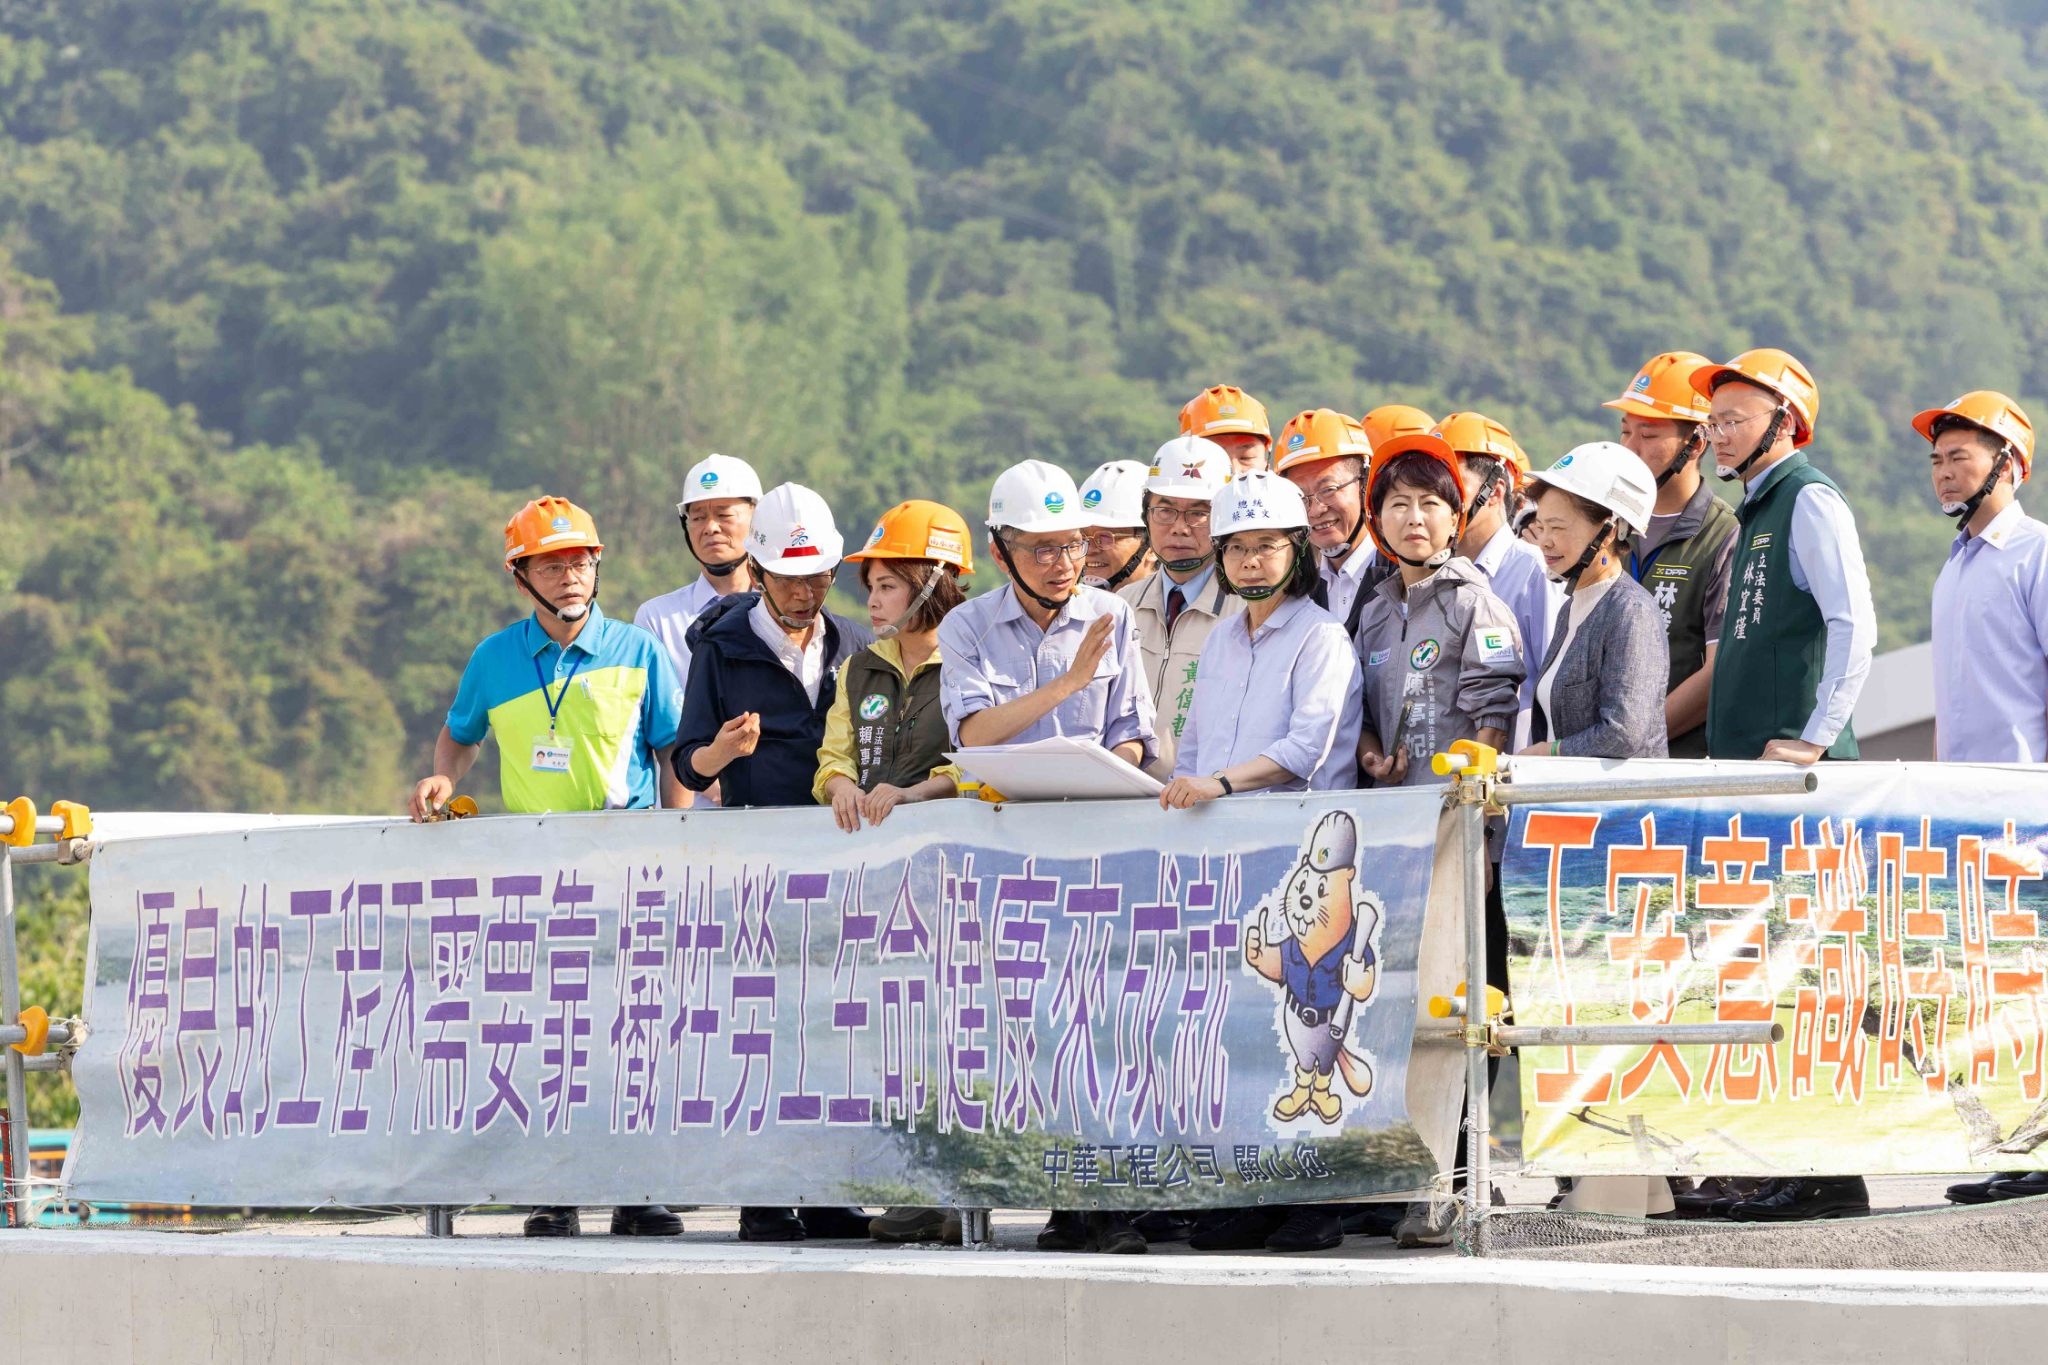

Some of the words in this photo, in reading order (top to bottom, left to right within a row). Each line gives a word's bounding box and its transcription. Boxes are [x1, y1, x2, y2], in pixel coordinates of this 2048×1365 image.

[1232, 509, 1270, 522] 蔡英文
[1237, 498, 1263, 509] 總統
[1664, 568, 1688, 576] DPP
[1751, 552, 1767, 625] 立法委員
[1733, 561, 1755, 640] 林宜瑾
[1402, 672, 1428, 760] 陳亭妃
[872, 725, 886, 766] 立法委員
[1522, 811, 2046, 1105] 工安意識時時
[1042, 1142, 1226, 1188] 中華工程公司
[1232, 1143, 1336, 1185] 關心您
